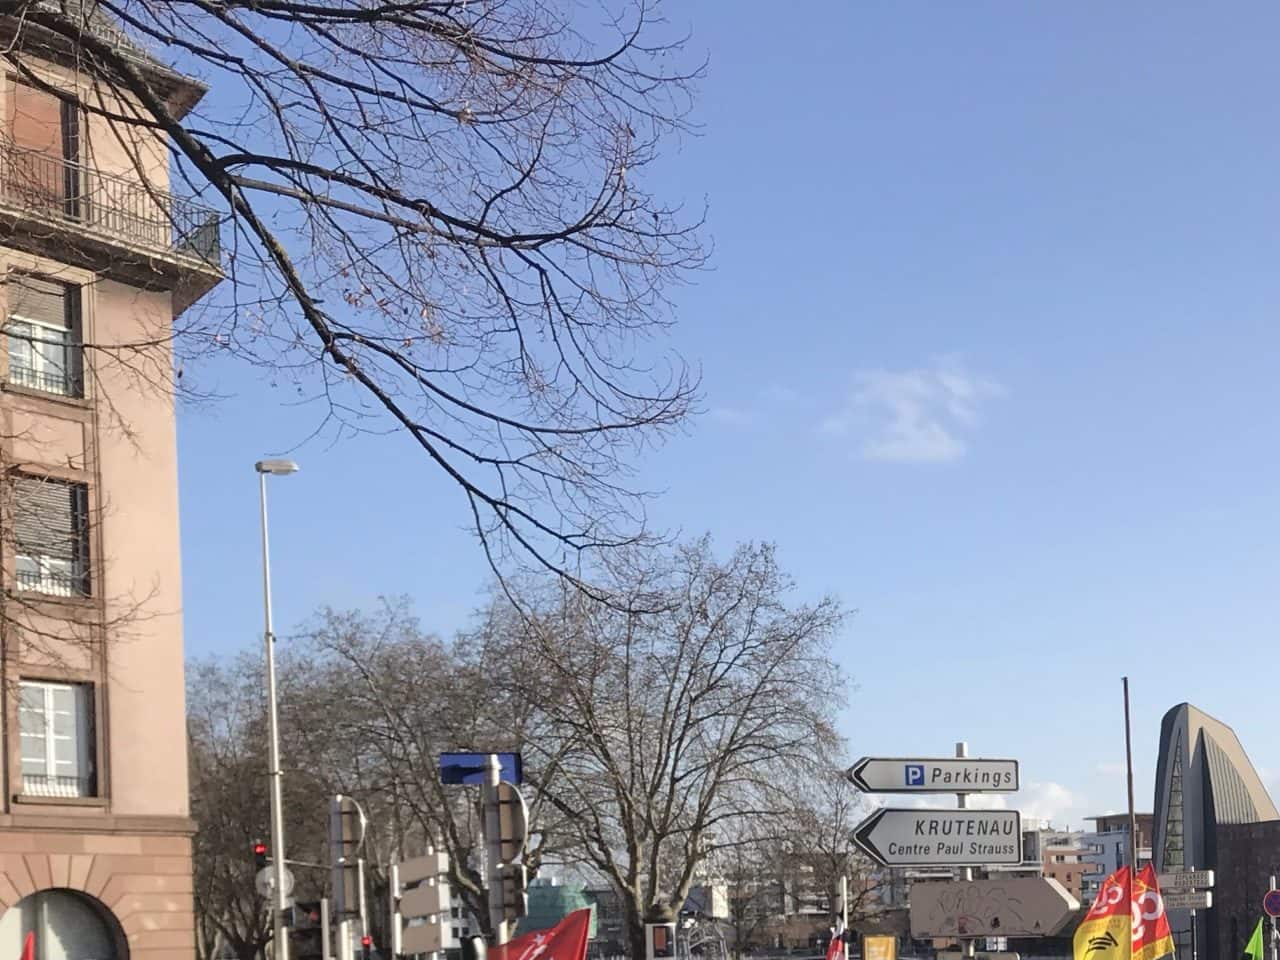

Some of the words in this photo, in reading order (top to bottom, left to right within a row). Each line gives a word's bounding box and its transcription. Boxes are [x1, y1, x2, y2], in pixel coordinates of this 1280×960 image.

[931, 767, 1012, 787] Parkings
[915, 819, 1014, 836] KRUTENAU
[888, 842, 931, 856] Centre
[937, 842, 963, 855] Paul
[969, 842, 1015, 855] Strauss
